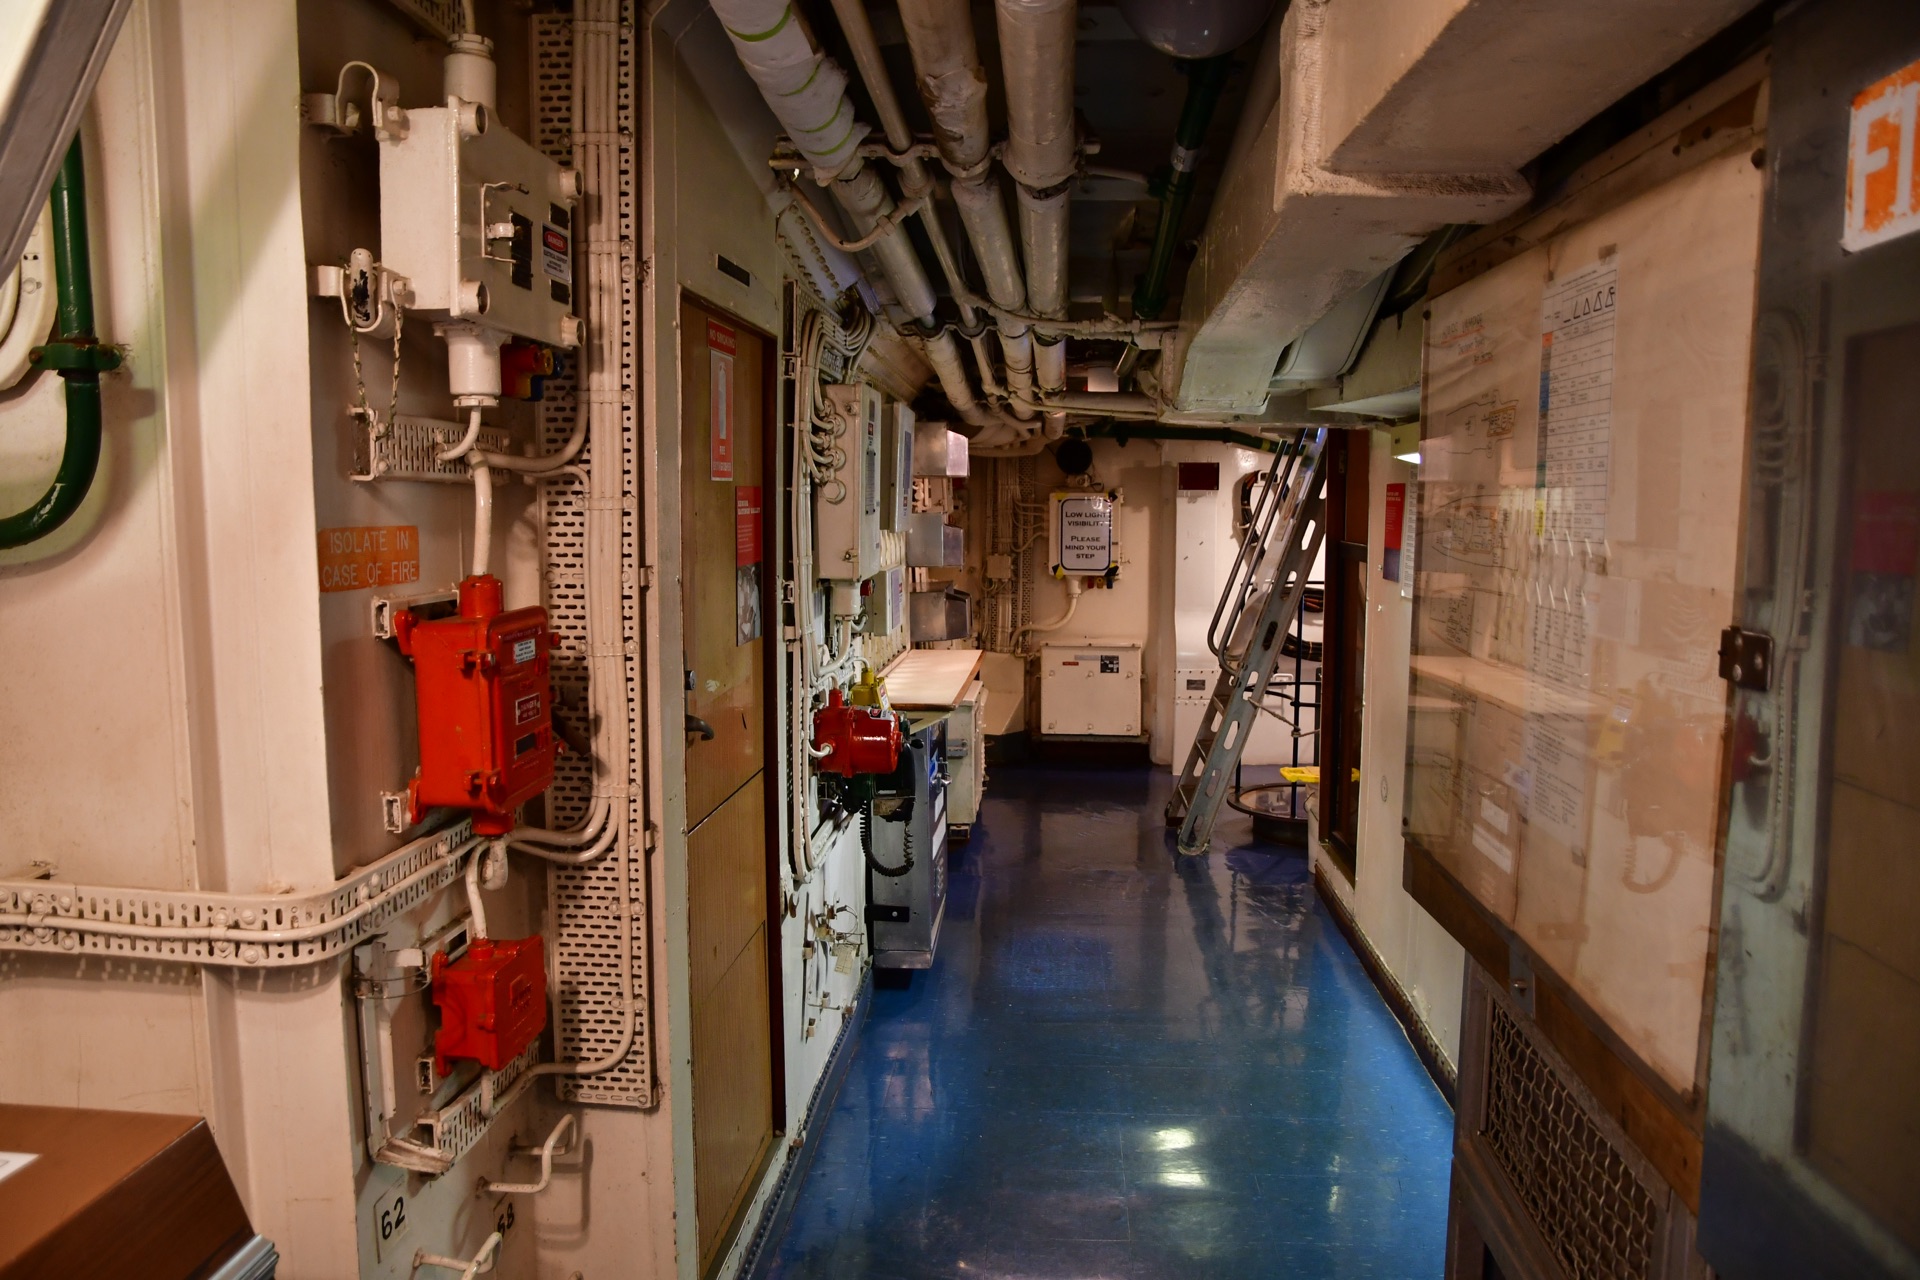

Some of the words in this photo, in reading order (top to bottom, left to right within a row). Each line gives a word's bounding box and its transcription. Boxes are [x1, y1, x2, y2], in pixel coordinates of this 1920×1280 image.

[709, 329, 716, 341] NO
[716, 331, 735, 349] SMOKING
[330, 530, 388, 554] ISOLATE
[396, 530, 409, 551] IN
[322, 563, 359, 588] CASE
[366, 562, 382, 584] OF
[391, 561, 418, 582] FIRE
[381, 1196, 406, 1240] 62
